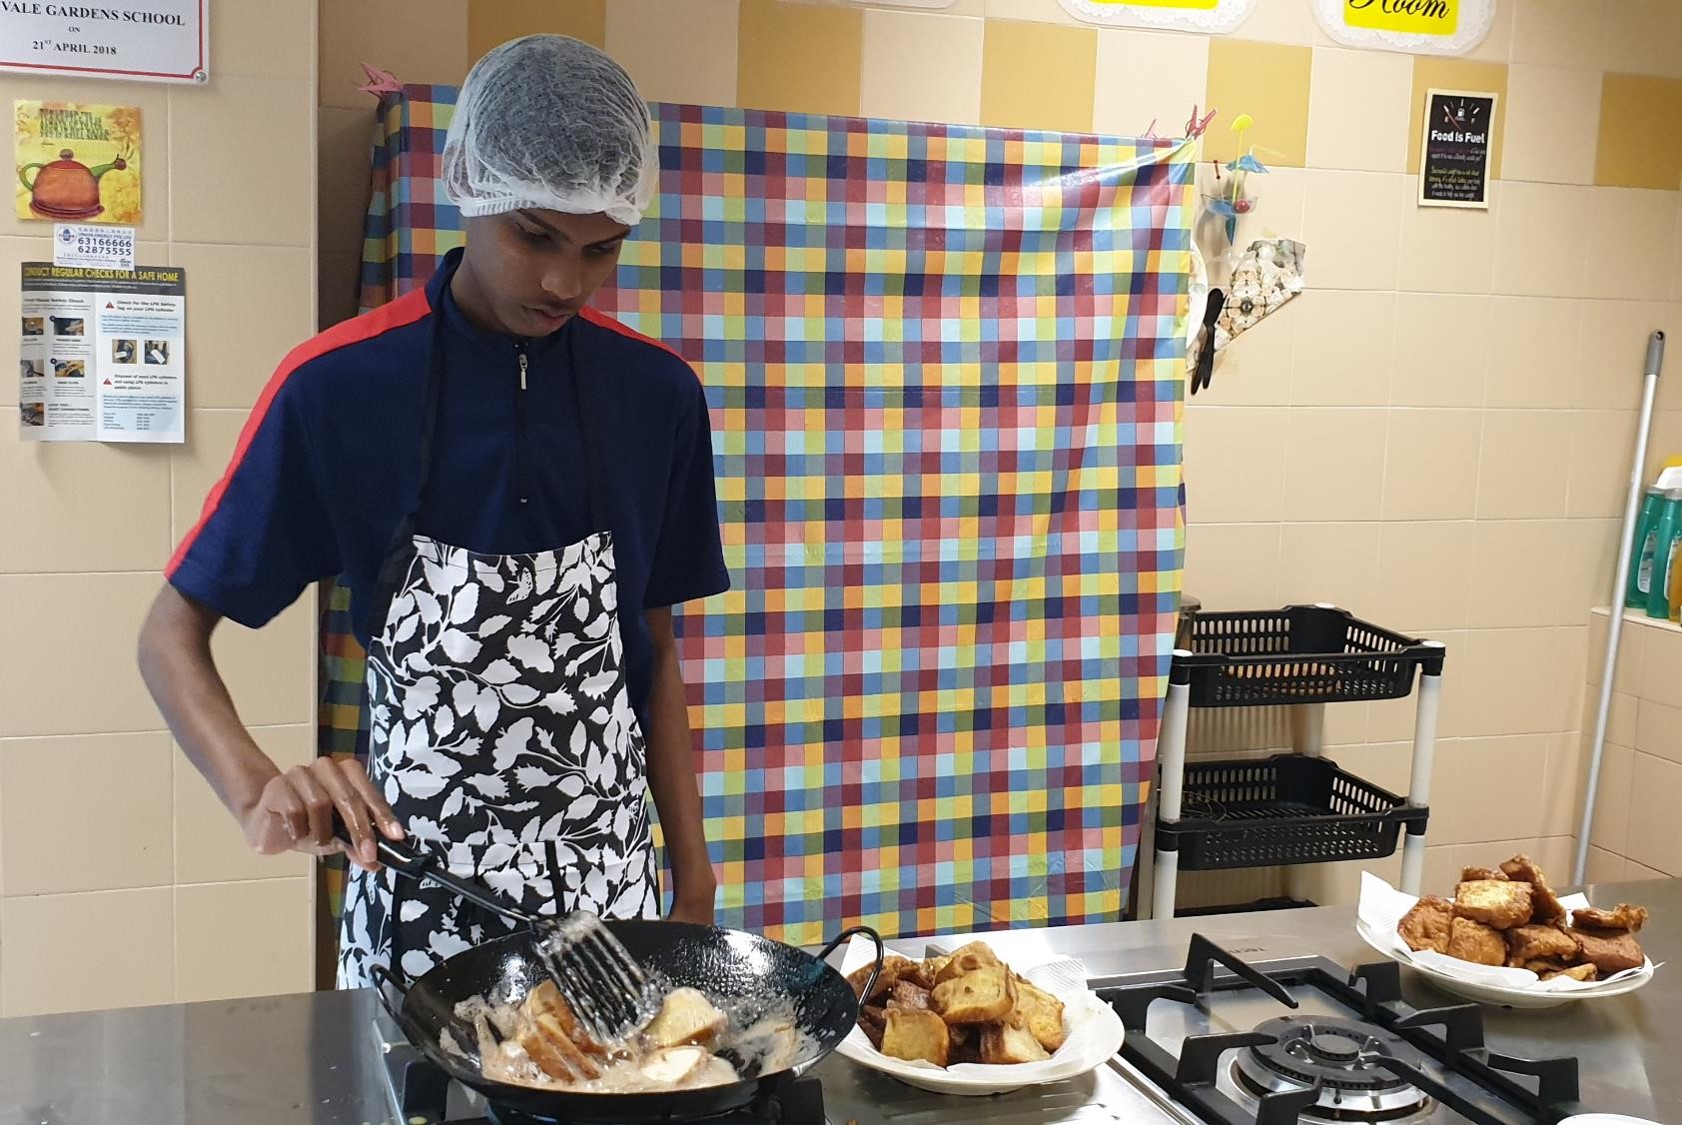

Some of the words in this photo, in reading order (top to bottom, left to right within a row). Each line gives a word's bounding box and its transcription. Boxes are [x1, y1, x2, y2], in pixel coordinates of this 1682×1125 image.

[1, 1, 41, 15] VALE
[46, 4, 119, 21] GARDENS
[123, 11, 186, 26] SCHOOL
[54, 43, 91, 54] APRIL
[93, 45, 117, 56] 2018
[1431, 130, 1454, 142] Food
[1465, 132, 1485, 144] Fuel
[78, 237, 132, 248] 63166666
[77, 245, 132, 256] 62875555
[51, 267, 84, 278] REGULAR
[85, 268, 114, 279] CHECKS
[115, 269, 130, 280] FOR
[131, 271, 138, 280] A
[138, 271, 156, 281] SAFE
[156, 272, 179, 282] HOME
